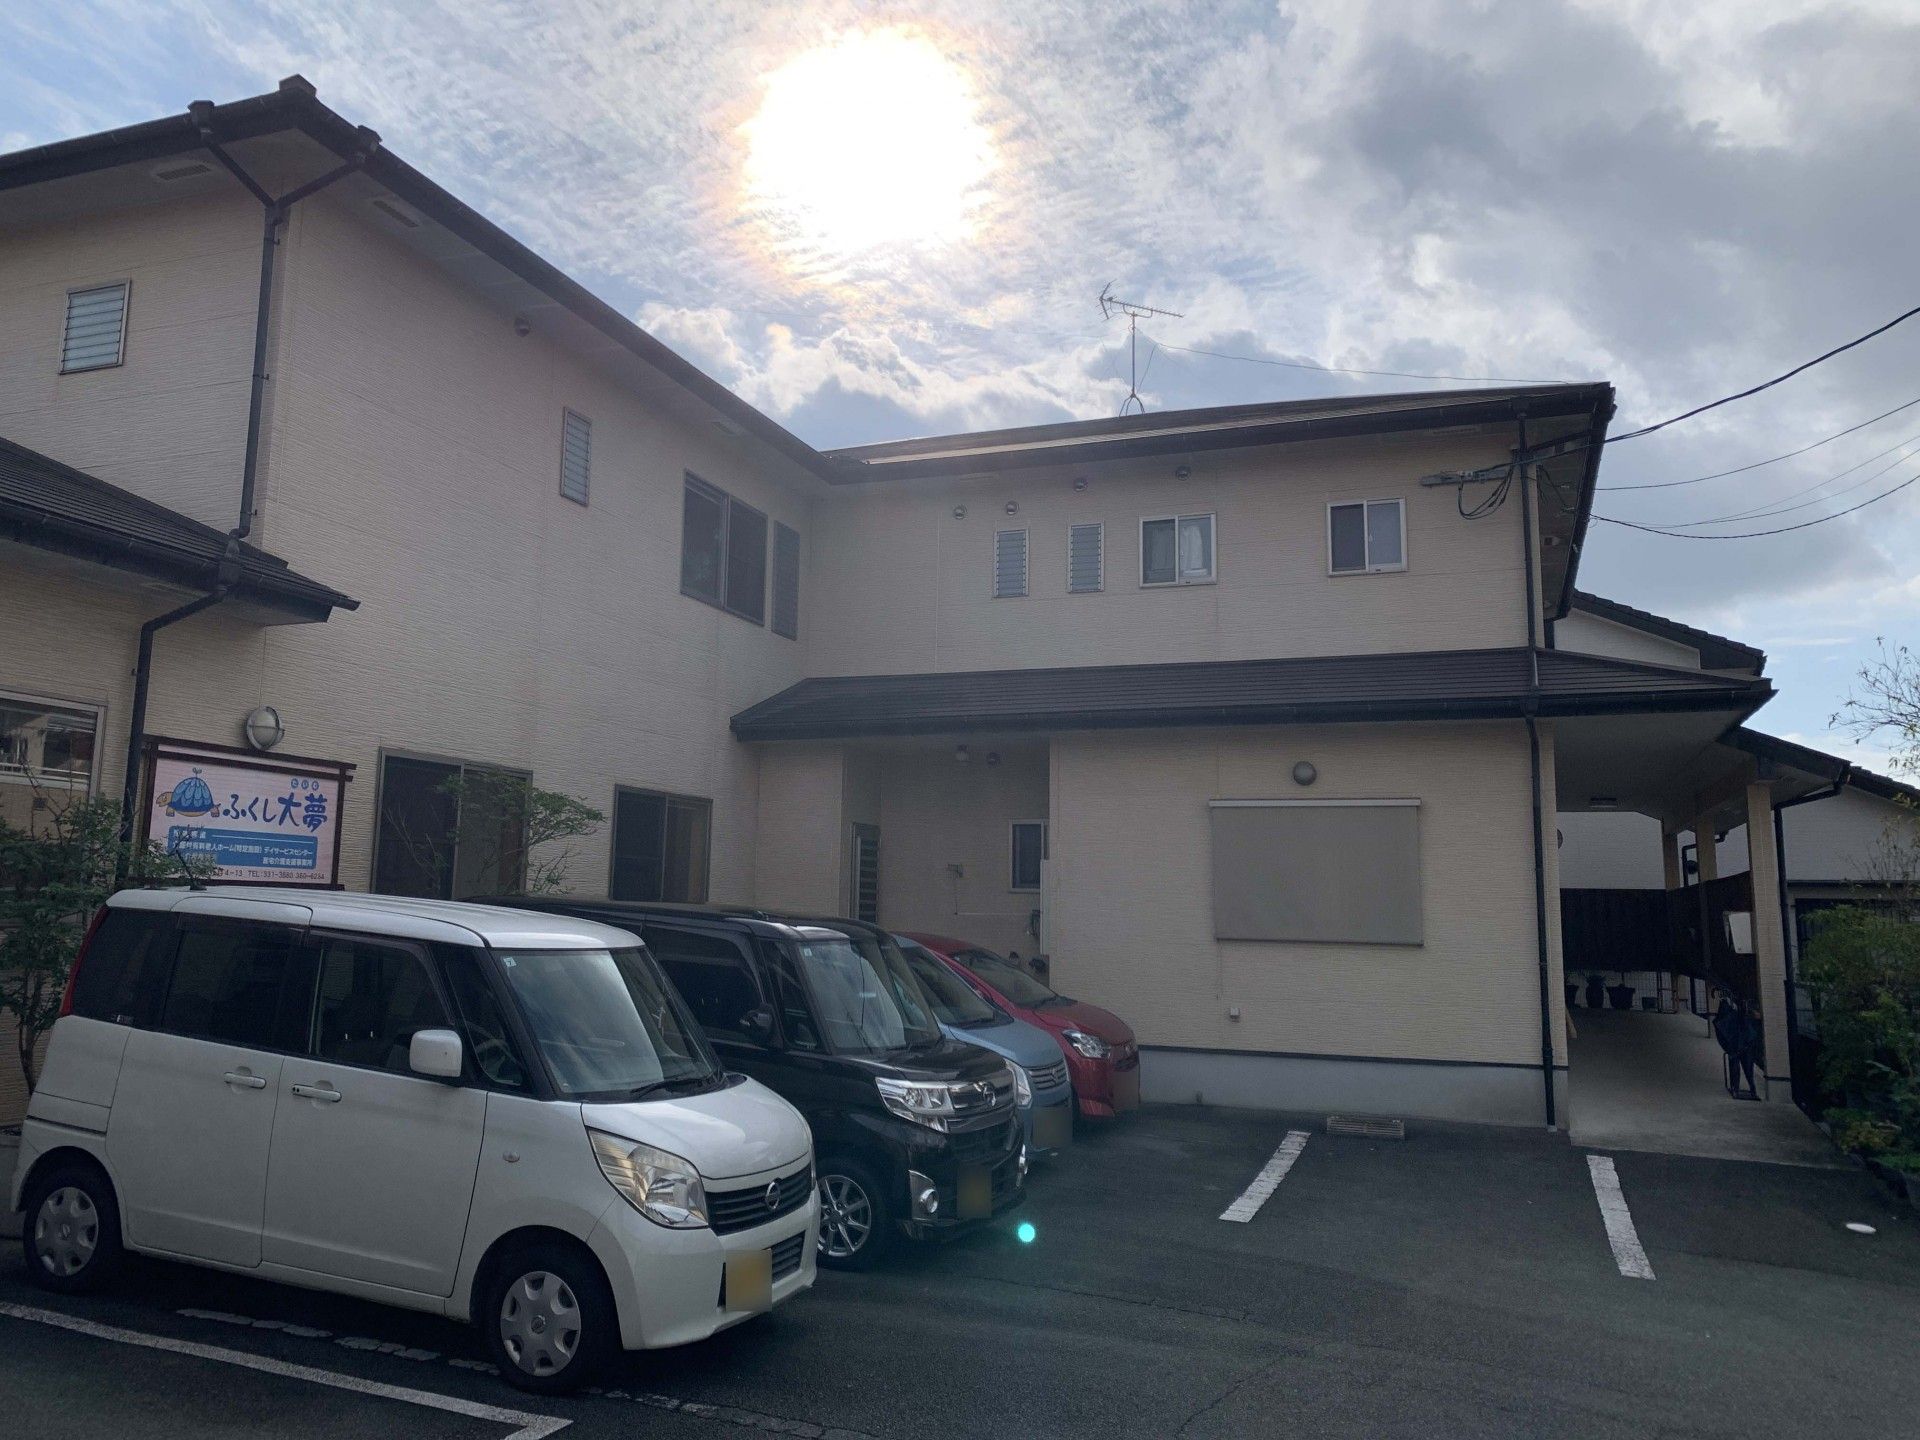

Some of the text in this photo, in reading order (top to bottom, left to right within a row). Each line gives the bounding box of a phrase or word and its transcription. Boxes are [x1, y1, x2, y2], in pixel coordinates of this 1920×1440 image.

[222, 792, 328, 833] ふくし大夢
